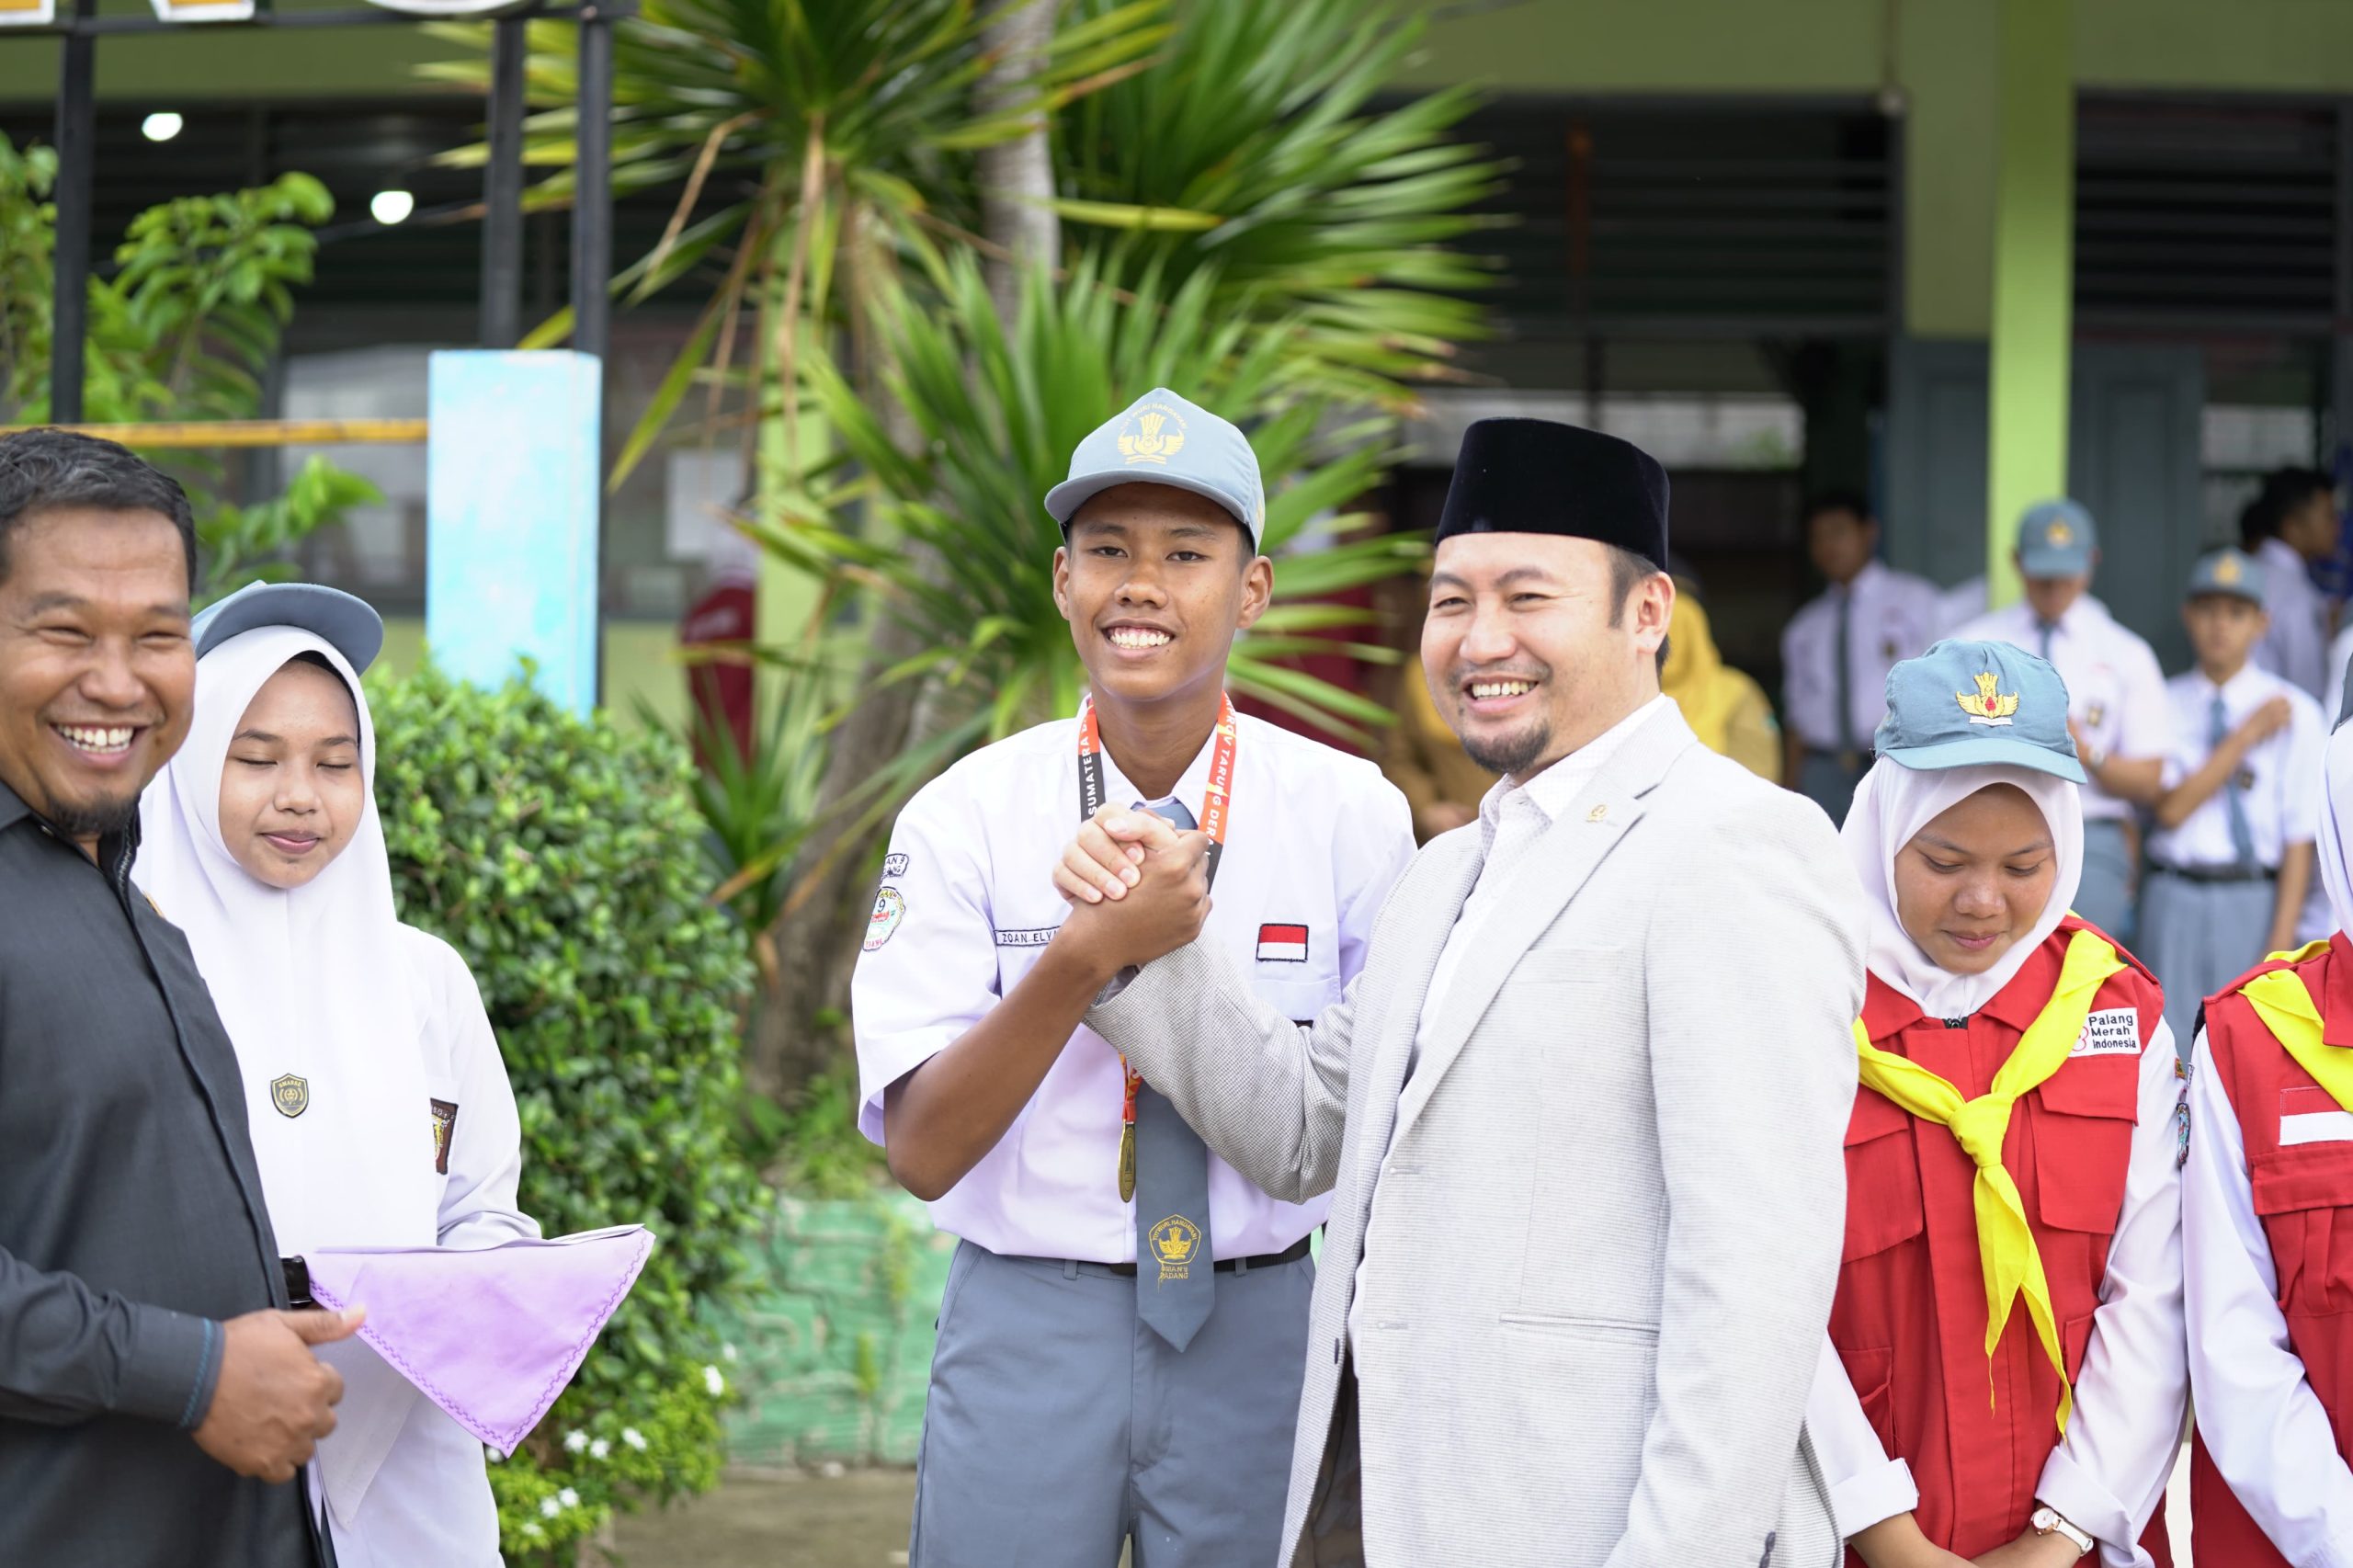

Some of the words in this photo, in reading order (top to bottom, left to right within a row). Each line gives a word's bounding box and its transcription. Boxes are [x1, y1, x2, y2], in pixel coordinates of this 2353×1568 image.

[1080, 737, 1097, 815] SUMATERA
[1212, 750, 1230, 806] TARUNG
[1205, 809, 1220, 856] DERA
[878, 898, 886, 913] 9
[1033, 930, 1057, 942] ELY
[2088, 1014, 2133, 1027] Palang
[2091, 1026, 2131, 1037] Merah
[2093, 1038, 2136, 1049] Indonesia
